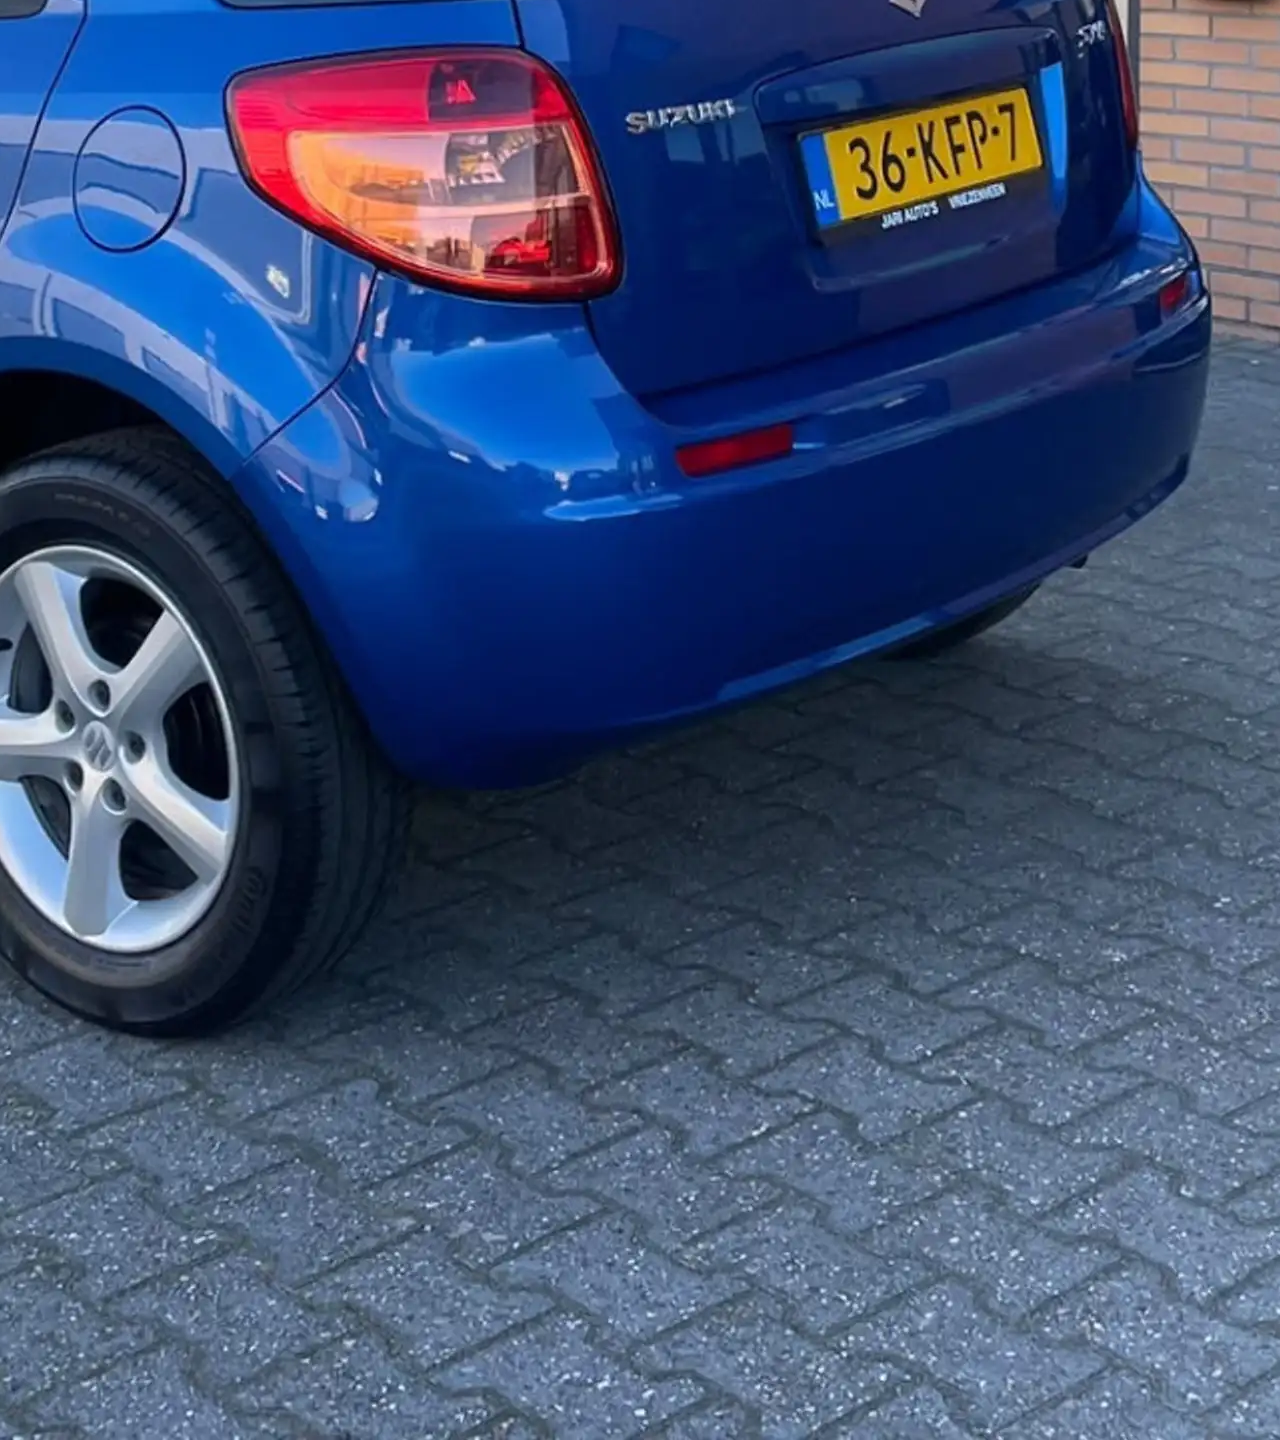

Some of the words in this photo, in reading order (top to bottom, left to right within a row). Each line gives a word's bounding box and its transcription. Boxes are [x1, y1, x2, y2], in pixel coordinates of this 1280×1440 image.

[625, 99, 736, 134] SUZUKI
[848, 102, 1015, 201] 36-KFP-7
[813, 189, 835, 210] NL
